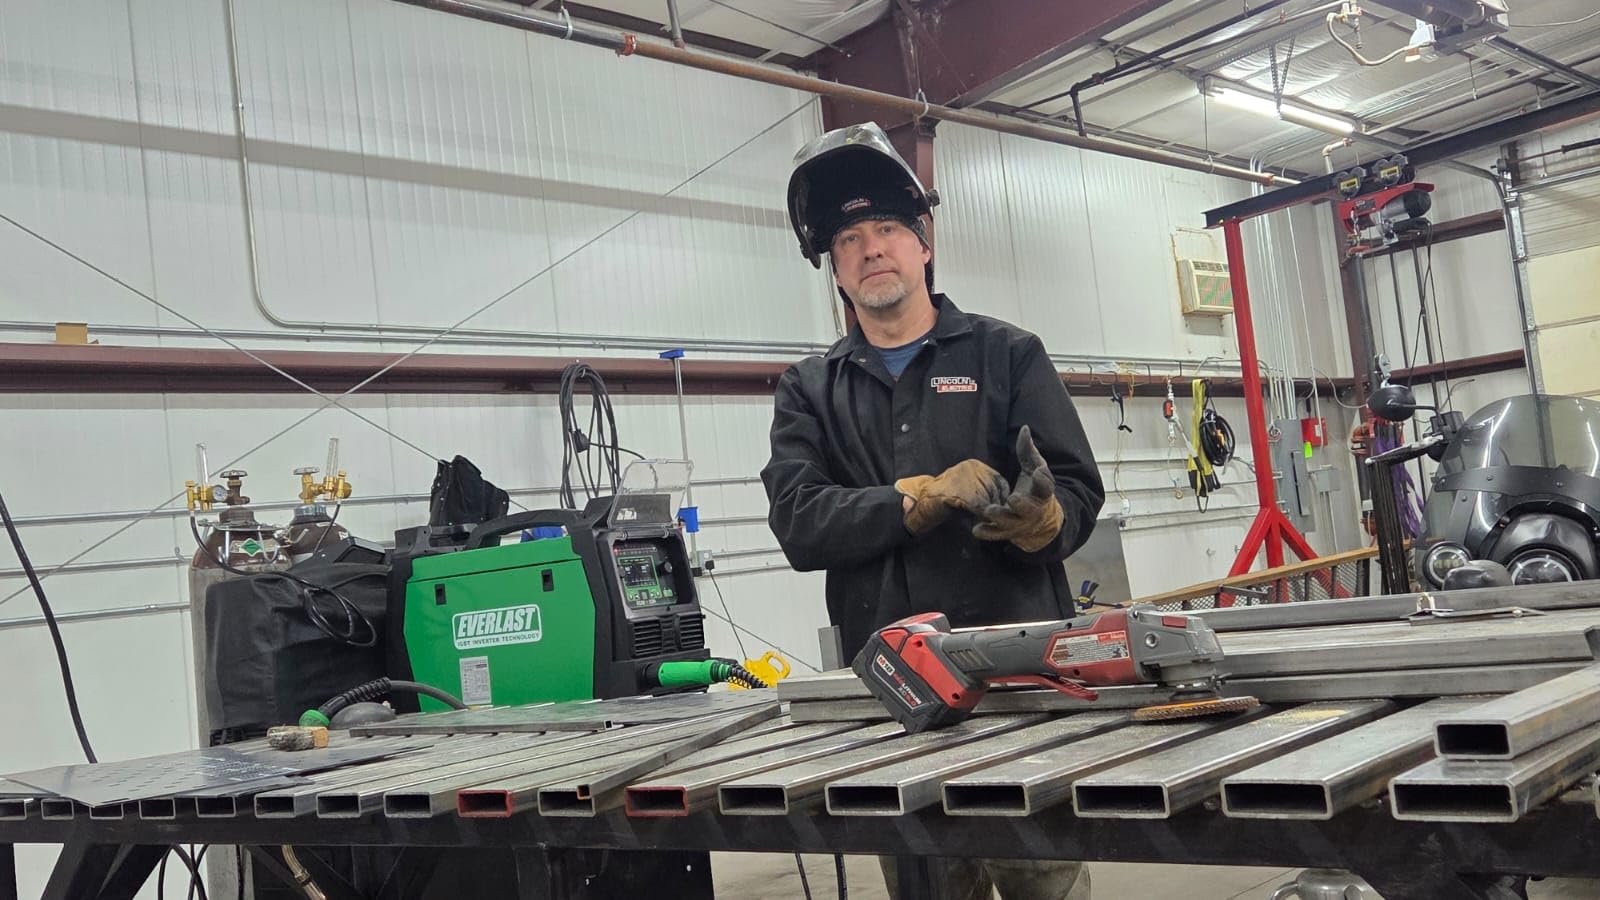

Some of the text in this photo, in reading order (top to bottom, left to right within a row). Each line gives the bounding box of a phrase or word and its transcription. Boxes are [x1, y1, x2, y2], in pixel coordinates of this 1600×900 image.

[932, 377, 971, 385] LINCOLN
[457, 607, 536, 638] EVERLAST
[471, 637, 500, 646] INVERTER
[502, 633, 540, 643] TECHNOLOGY
